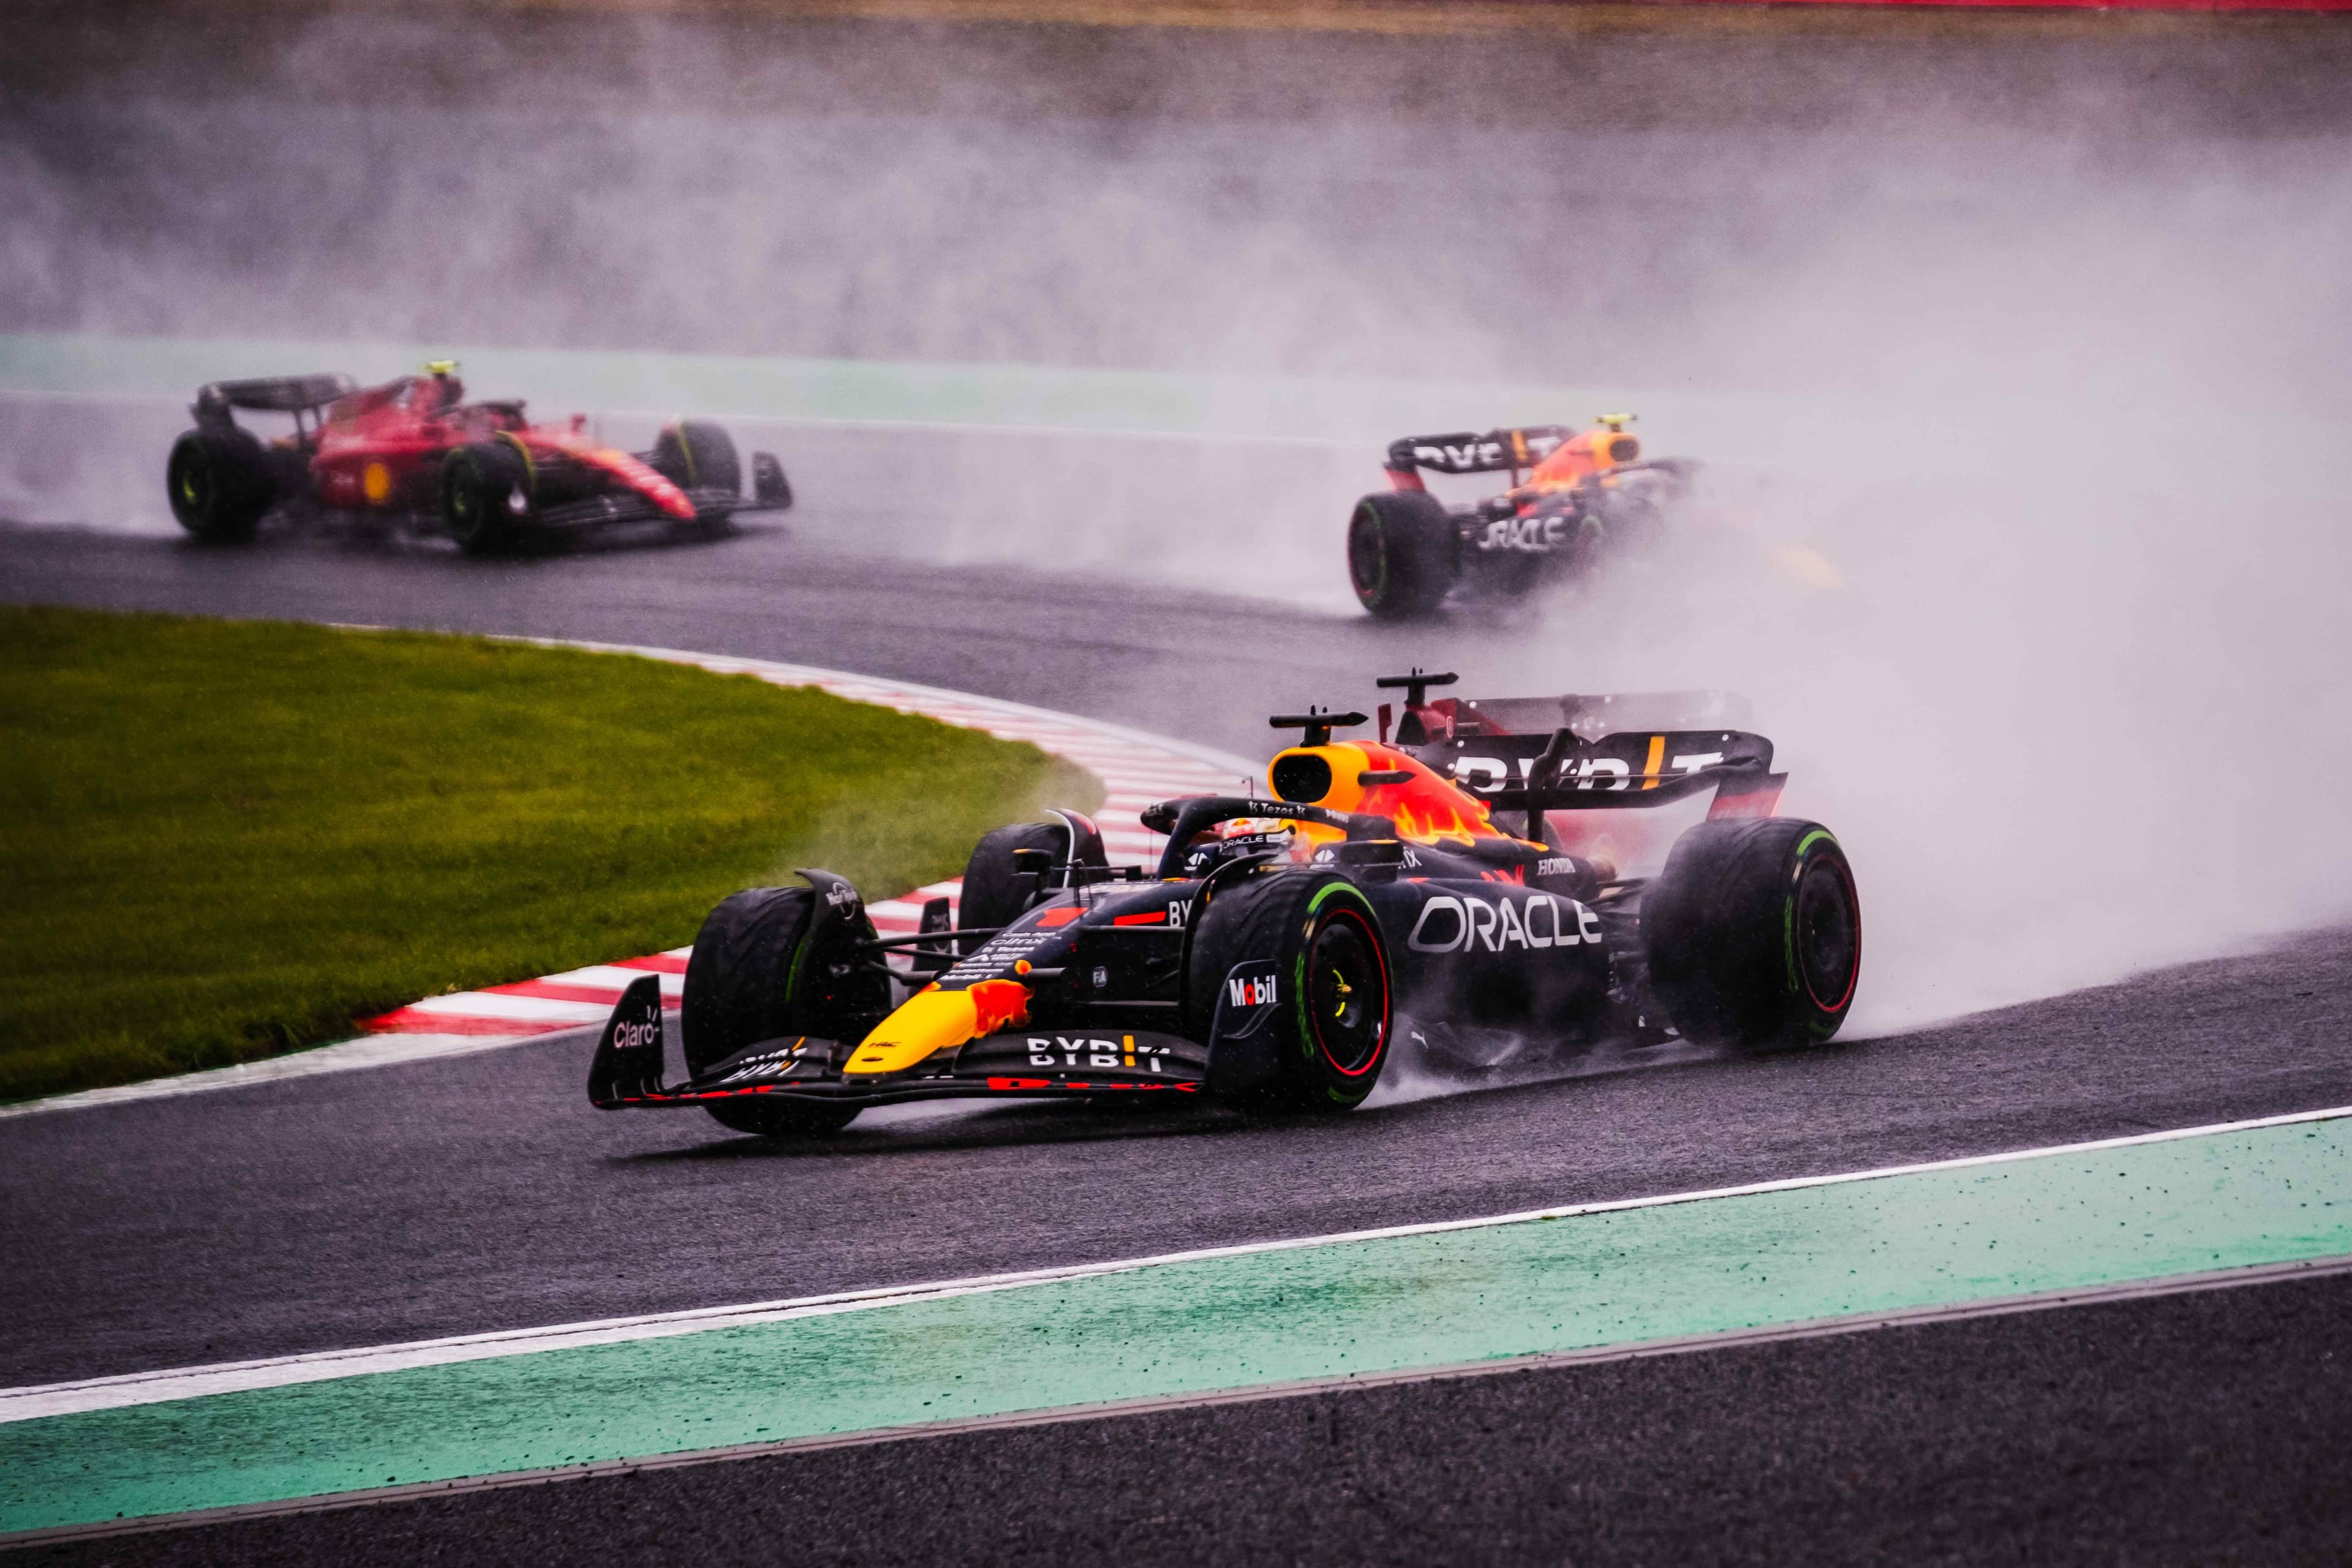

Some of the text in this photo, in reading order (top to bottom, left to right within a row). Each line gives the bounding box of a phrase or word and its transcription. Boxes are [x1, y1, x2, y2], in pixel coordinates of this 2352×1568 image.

[1261, 802, 1294, 815] Tezos
[1537, 858, 1576, 875] HONDA
[1408, 895, 1602, 952] ORACLE
[1229, 974, 1276, 1006] Mobil
[614, 1020, 654, 1048] Claro
